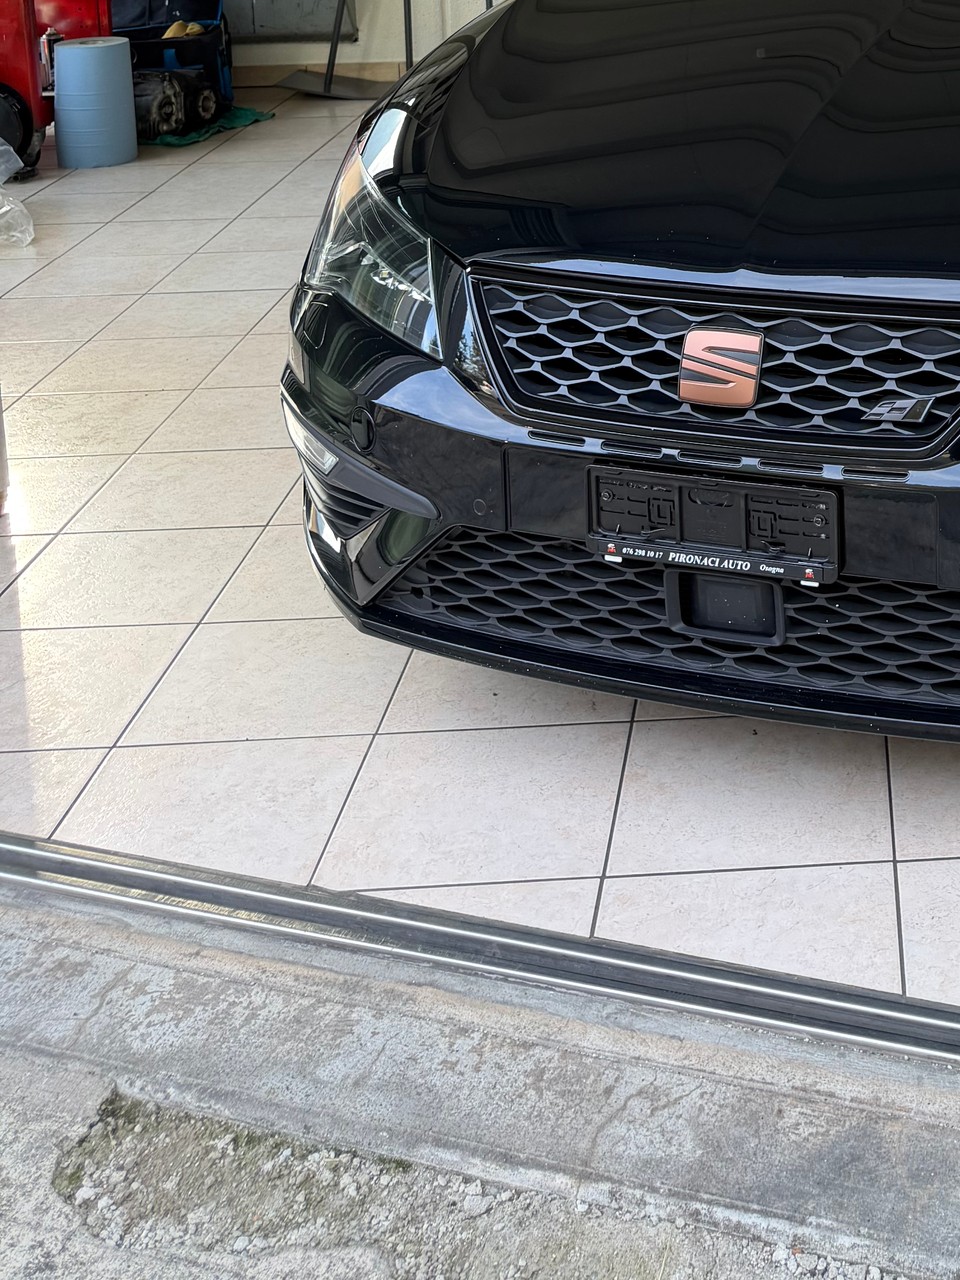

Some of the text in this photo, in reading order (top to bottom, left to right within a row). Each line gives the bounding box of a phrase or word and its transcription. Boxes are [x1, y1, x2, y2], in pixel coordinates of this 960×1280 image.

[622, 546, 785, 574] 076 298 10 17 PIRONACI AUTO Osogna
